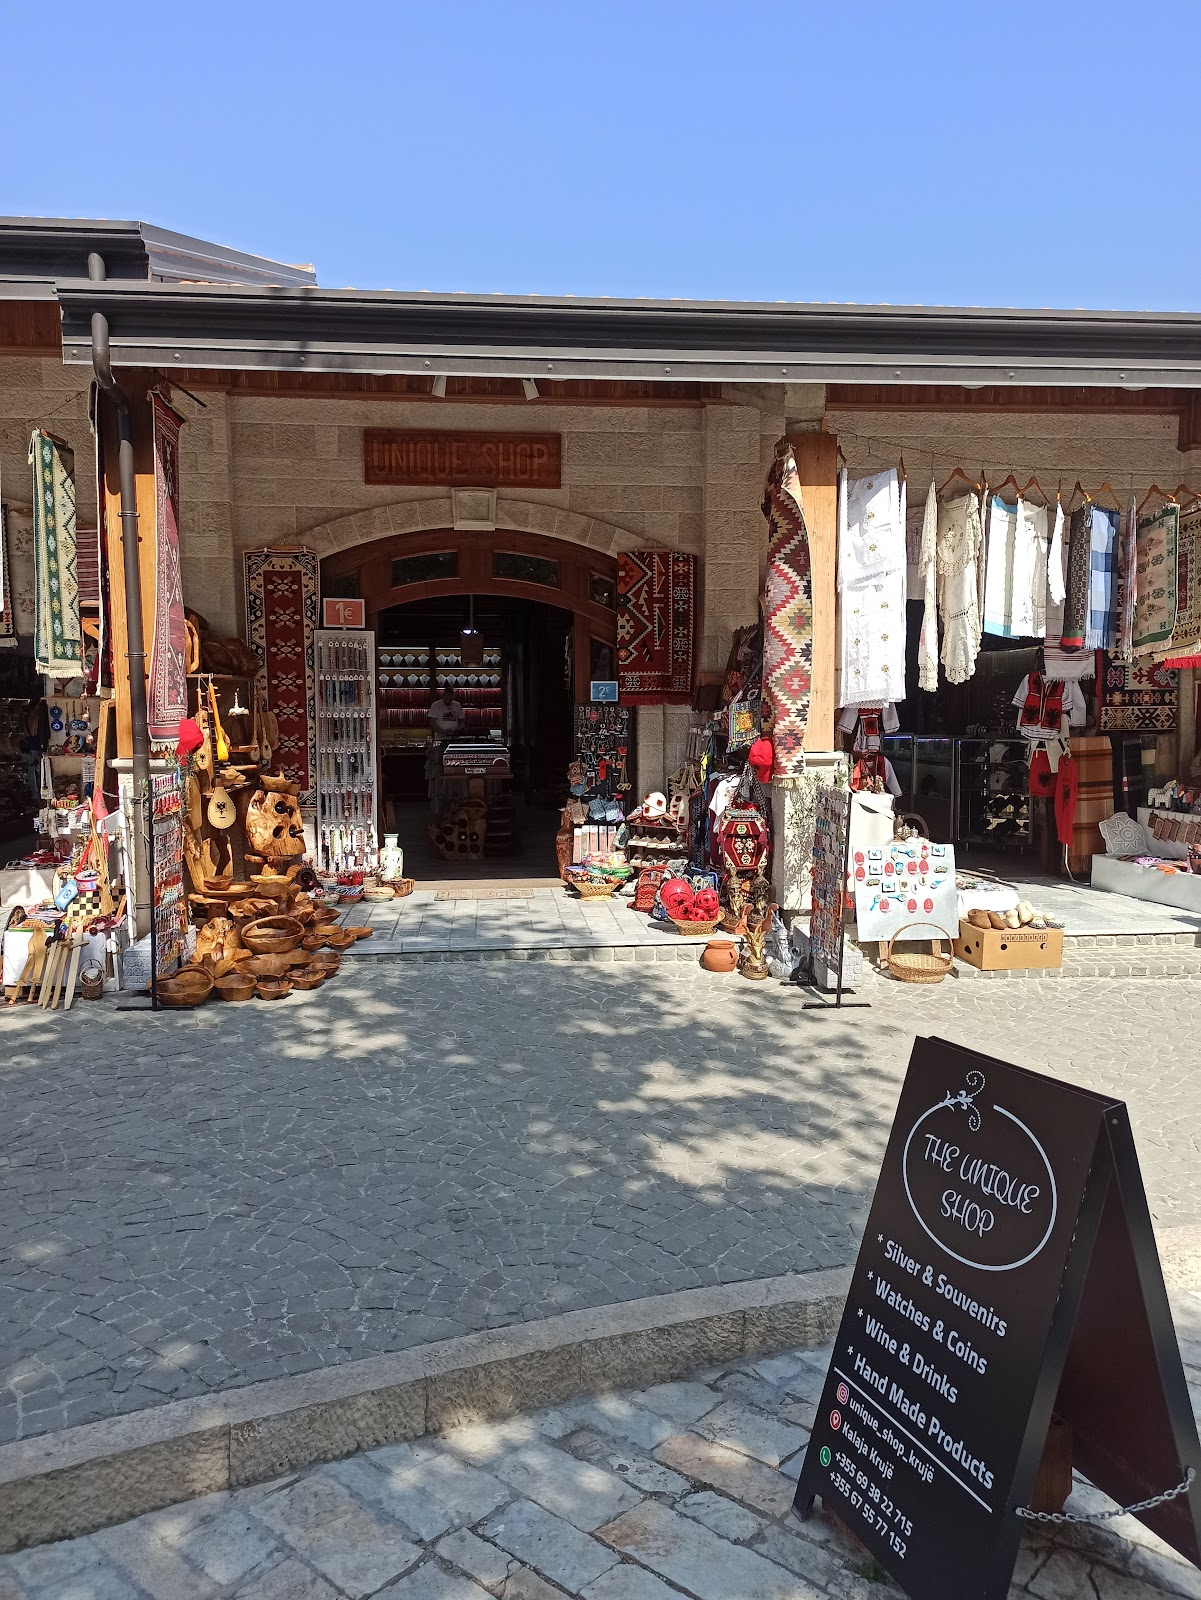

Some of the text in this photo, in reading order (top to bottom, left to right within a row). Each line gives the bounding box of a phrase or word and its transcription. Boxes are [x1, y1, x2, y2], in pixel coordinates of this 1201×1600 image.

[372, 439, 549, 481] UNIQUE SHOP
[335, 602, 353, 624] 1€
[598, 686, 610, 697] 2€
[924, 1133, 1040, 1214] THE UNIQUE
[940, 1189, 995, 1237] SHOP
[875, 1276, 988, 1375] Watches & Coins
[884, 1239, 1007, 1337] Silver & Souvenirs
[865, 1314, 958, 1404] Wine & Drinks
[842, 1421, 895, 1480] Kalaja Krujë
[849, 1397, 935, 1483] unique_shop_krujë
[854, 1353, 995, 1489] Hand Made Products
[829, 1471, 908, 1560] +355 67 55 77 152
[835, 1451, 913, 1537] +355 69 38 22 715
